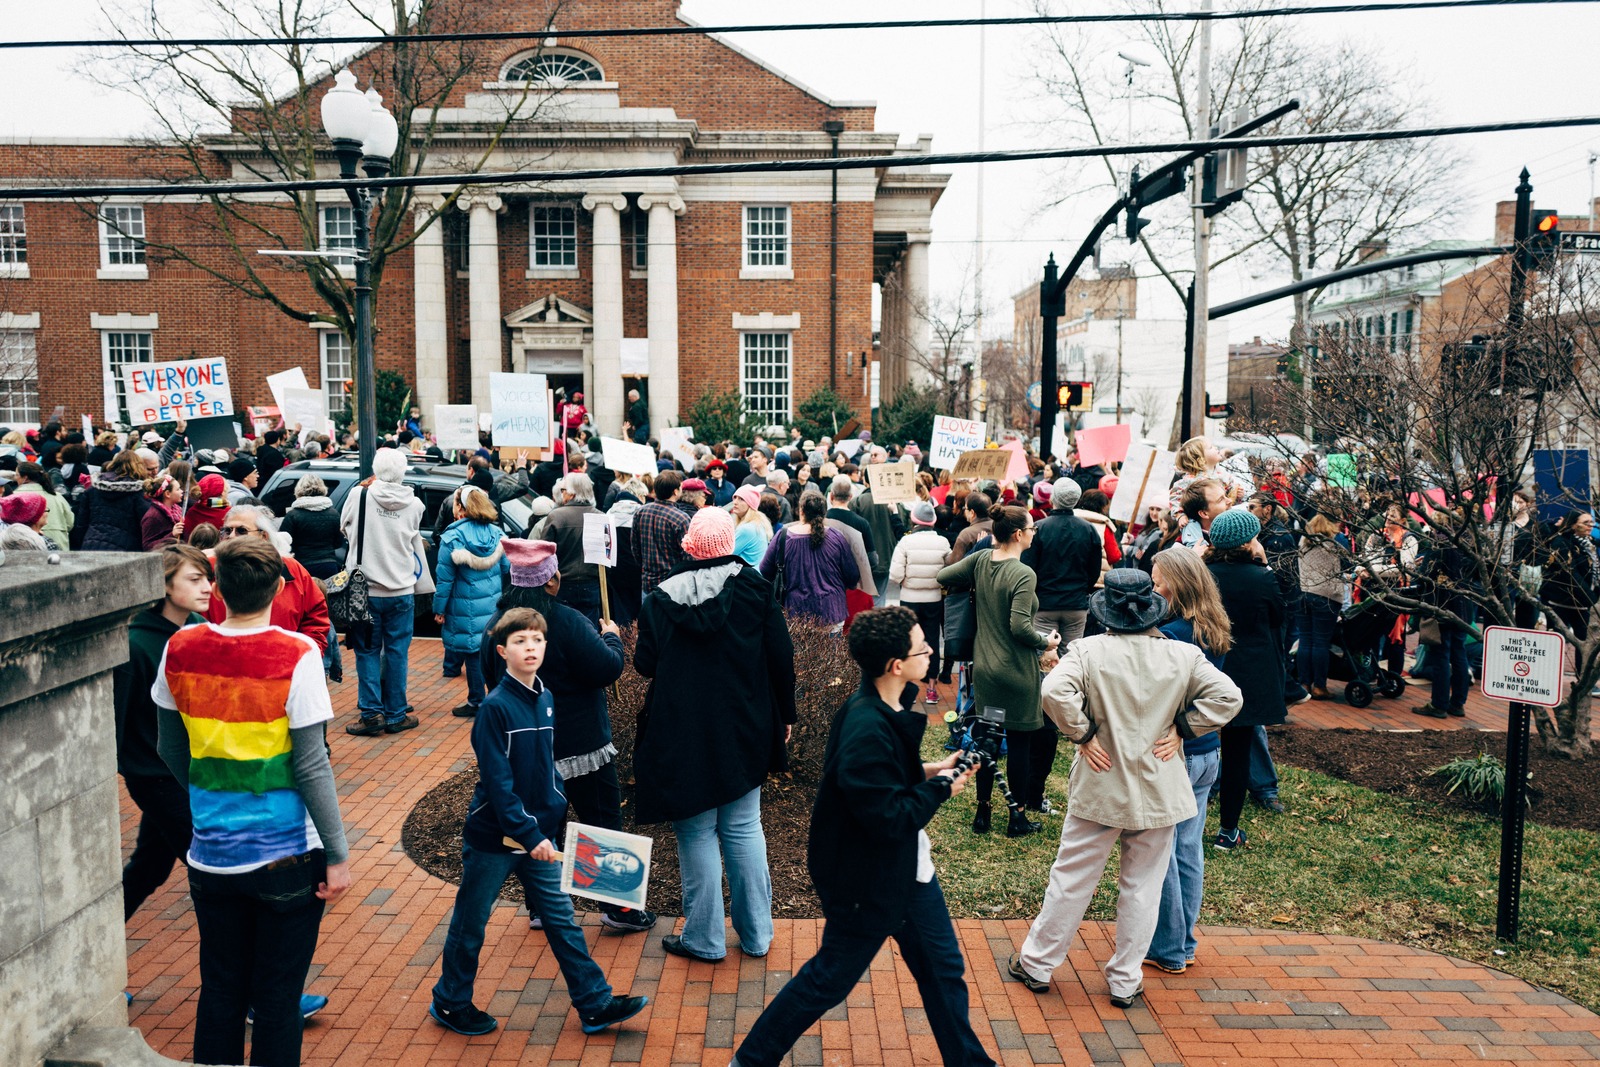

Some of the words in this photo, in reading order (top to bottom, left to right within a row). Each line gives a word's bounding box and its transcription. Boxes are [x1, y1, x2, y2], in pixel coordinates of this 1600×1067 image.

[1575, 236, 1600, 248] Bra
[132, 363, 224, 393] EVERYONE
[160, 390, 206, 407] DOES
[500, 390, 544, 403] VOICES
[143, 401, 224, 422] BETTER
[510, 416, 545, 436] HEARD
[940, 417, 979, 435] LOVE
[937, 431, 978, 449] TRUMPS
[939, 446, 966, 459] HAT
[1501, 645, 1522, 653] SMOKE
[1529, 648, 1546, 656] FREE
[1509, 654, 1536, 662] CAMPUS
[1504, 676, 1525, 684] THANK
[1526, 678, 1539, 686] YOU
[1521, 685, 1550, 696] SMOKING
